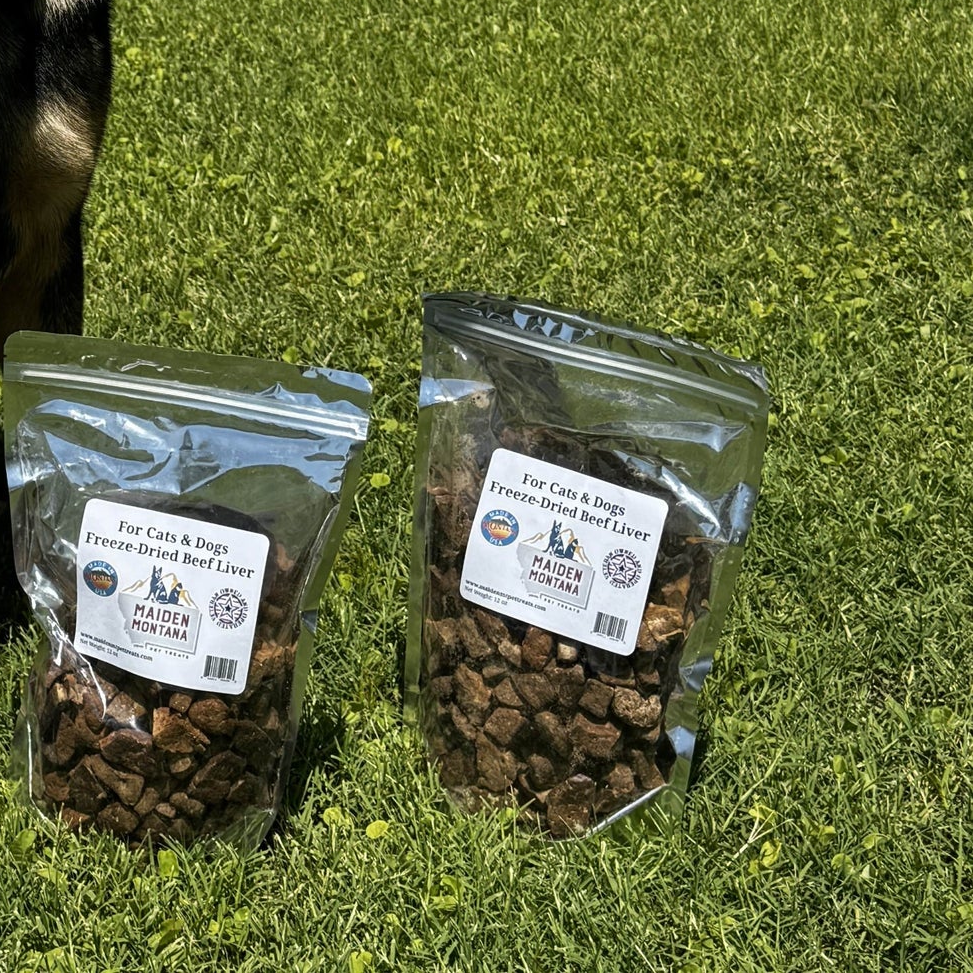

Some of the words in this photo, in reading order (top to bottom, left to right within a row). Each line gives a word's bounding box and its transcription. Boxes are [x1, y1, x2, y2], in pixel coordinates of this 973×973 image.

[522, 473, 546, 490] For
[550, 482, 577, 500] Cats
[580, 493, 590, 504] &
[593, 496, 626, 516] Dogs
[489, 481, 577, 519] Freeze-Dried
[579, 510, 611, 530] Beef
[613, 521, 651, 542] Liver
[118, 521, 143, 536] For
[147, 527, 177, 543] Cats
[180, 534, 192, 546] &
[195, 537, 229, 556] Dogs
[85, 532, 178, 562] Freeze-Dried
[182, 553, 214, 569] Beef
[217, 560, 254, 578] Liver
[88, 560, 107, 569] MADE
[532, 555, 583, 583] MAIDEN
[529, 570, 579, 596] MONTANA
[134, 604, 190, 627] MAIDEN
[557, 602, 580, 613] TREATS
[132, 619, 188, 642] MONTANA
[165, 650, 189, 659] TREATS
